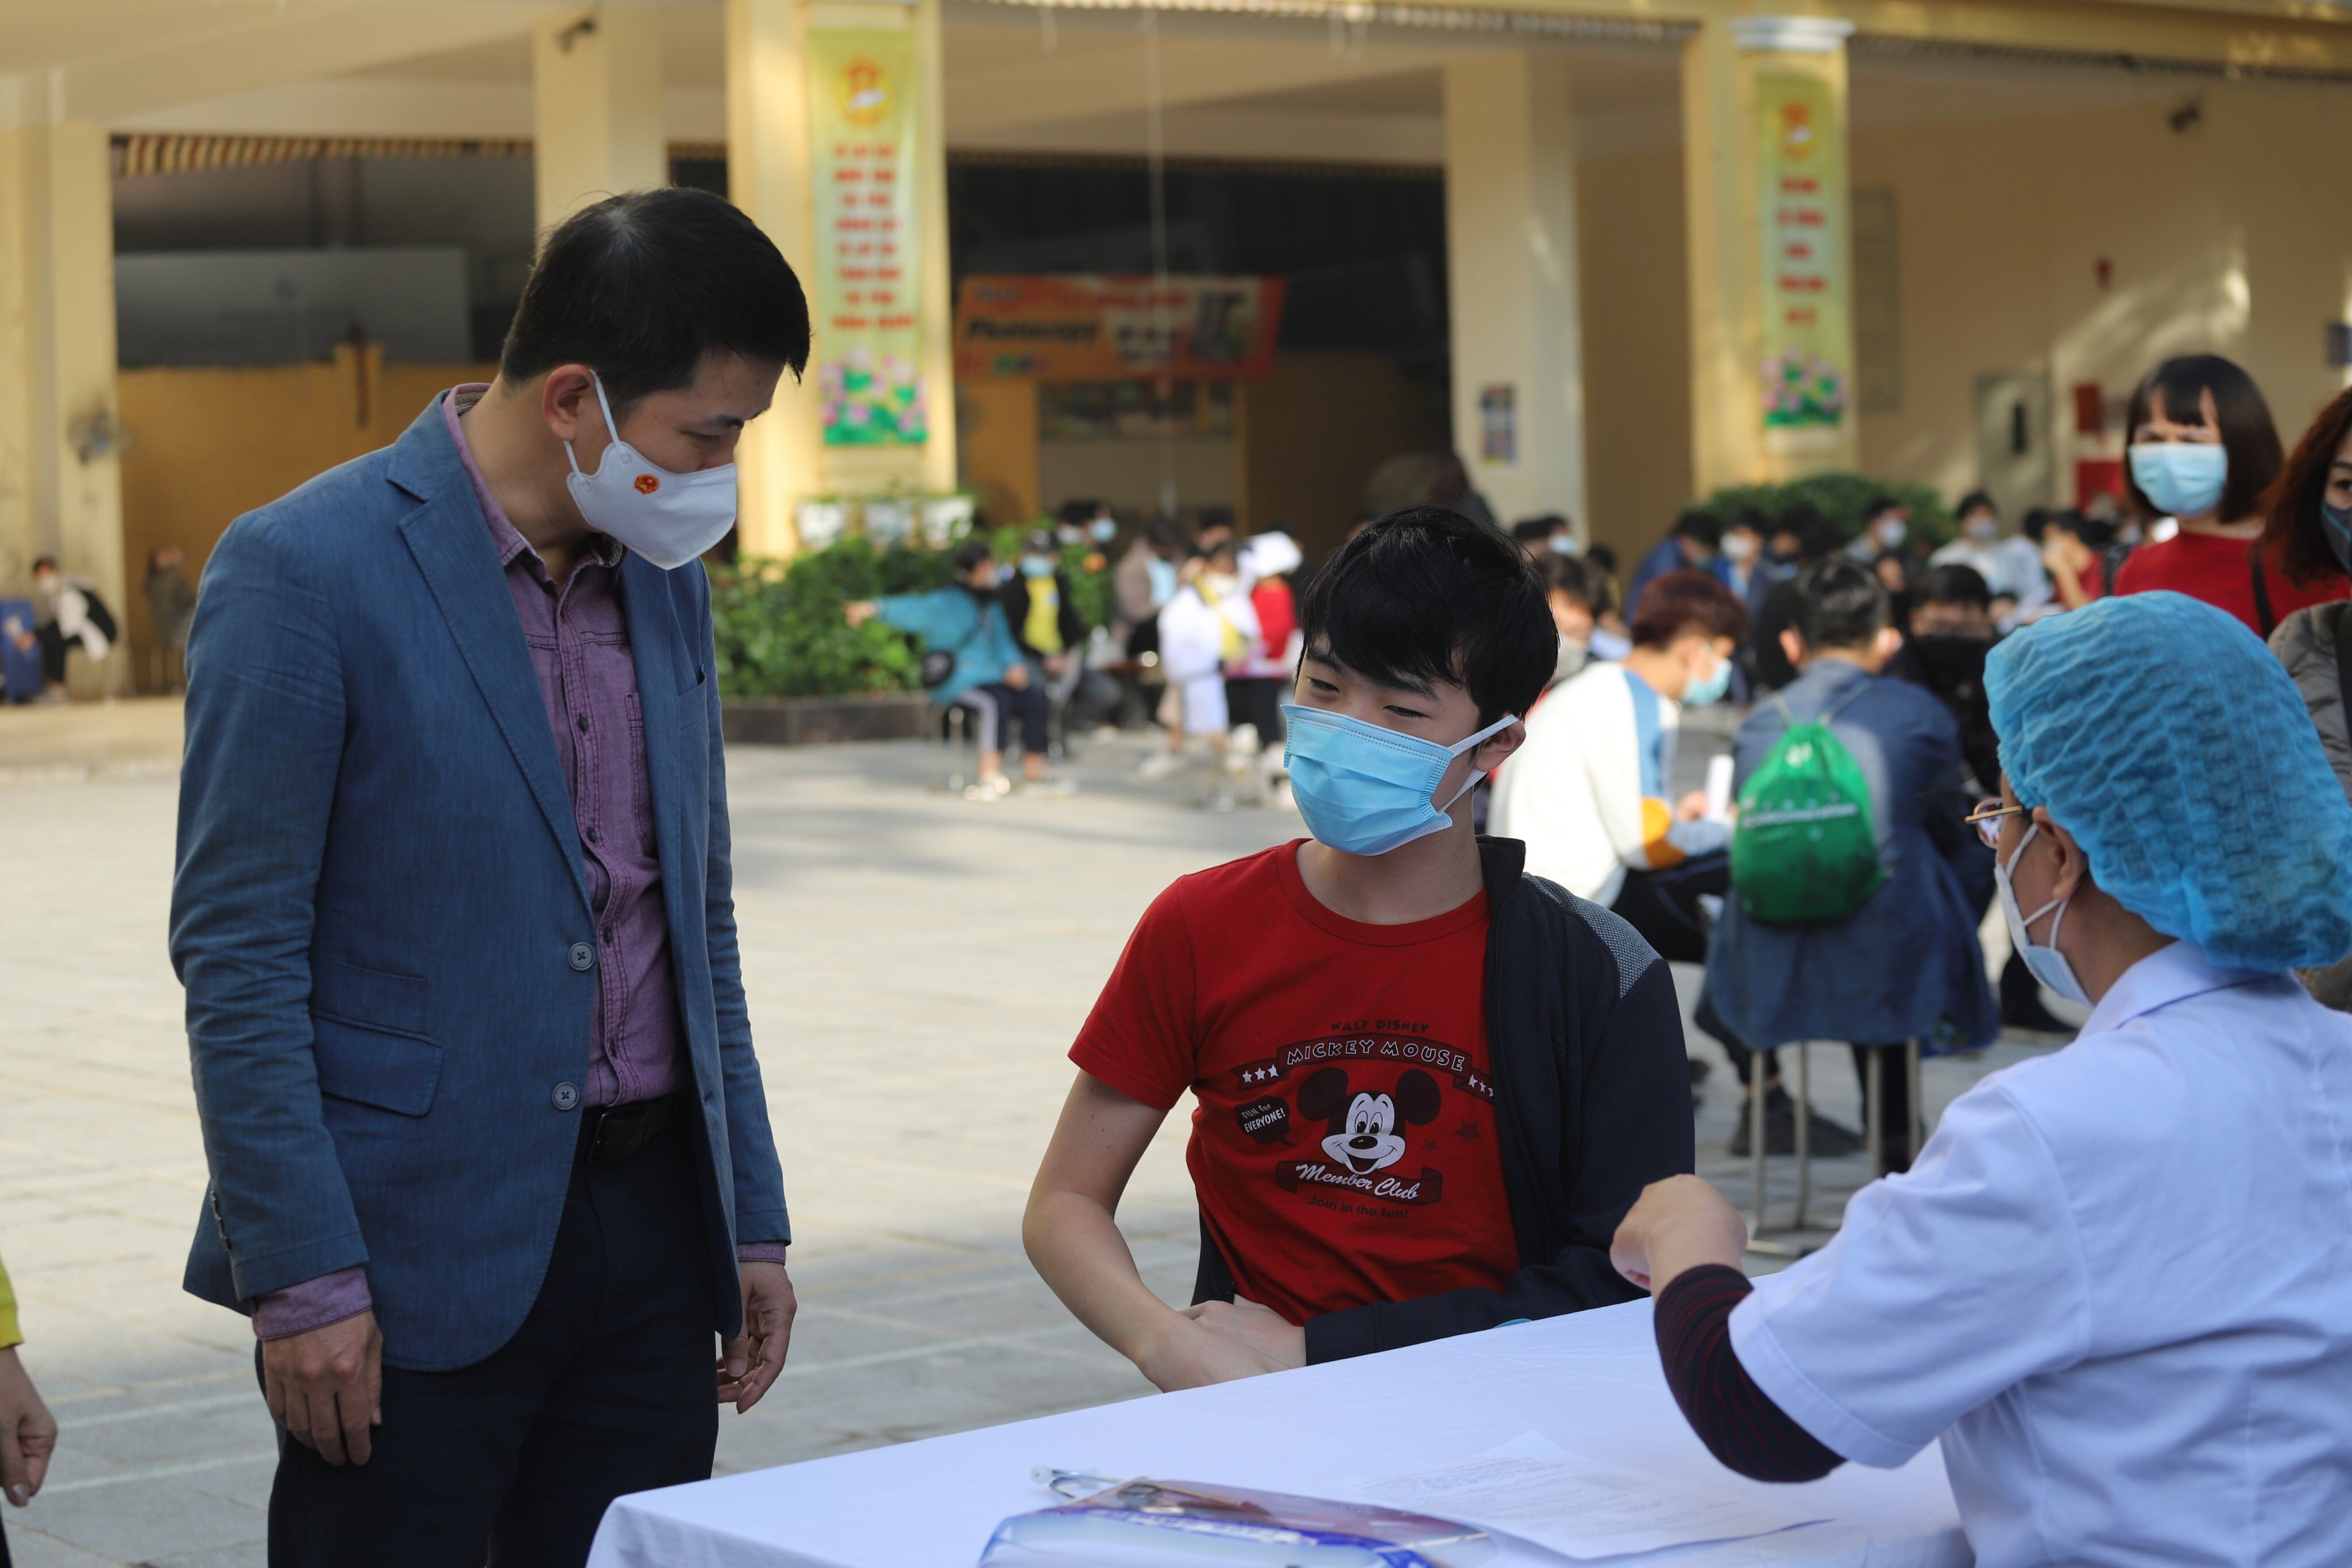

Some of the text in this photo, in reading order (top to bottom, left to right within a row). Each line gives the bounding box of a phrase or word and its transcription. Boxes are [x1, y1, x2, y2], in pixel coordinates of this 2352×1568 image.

[1330, 1020, 1430, 1033] WALT DISNEY
[1287, 1039, 1465, 1071] MICKEY MOUSE
[1241, 1108, 1260, 1119] FUN
[1244, 1108, 1285, 1133] EVERYONE!
[1296, 1164, 1420, 1199] Member Club
[1307, 1195, 1409, 1218] Join in the fun!
